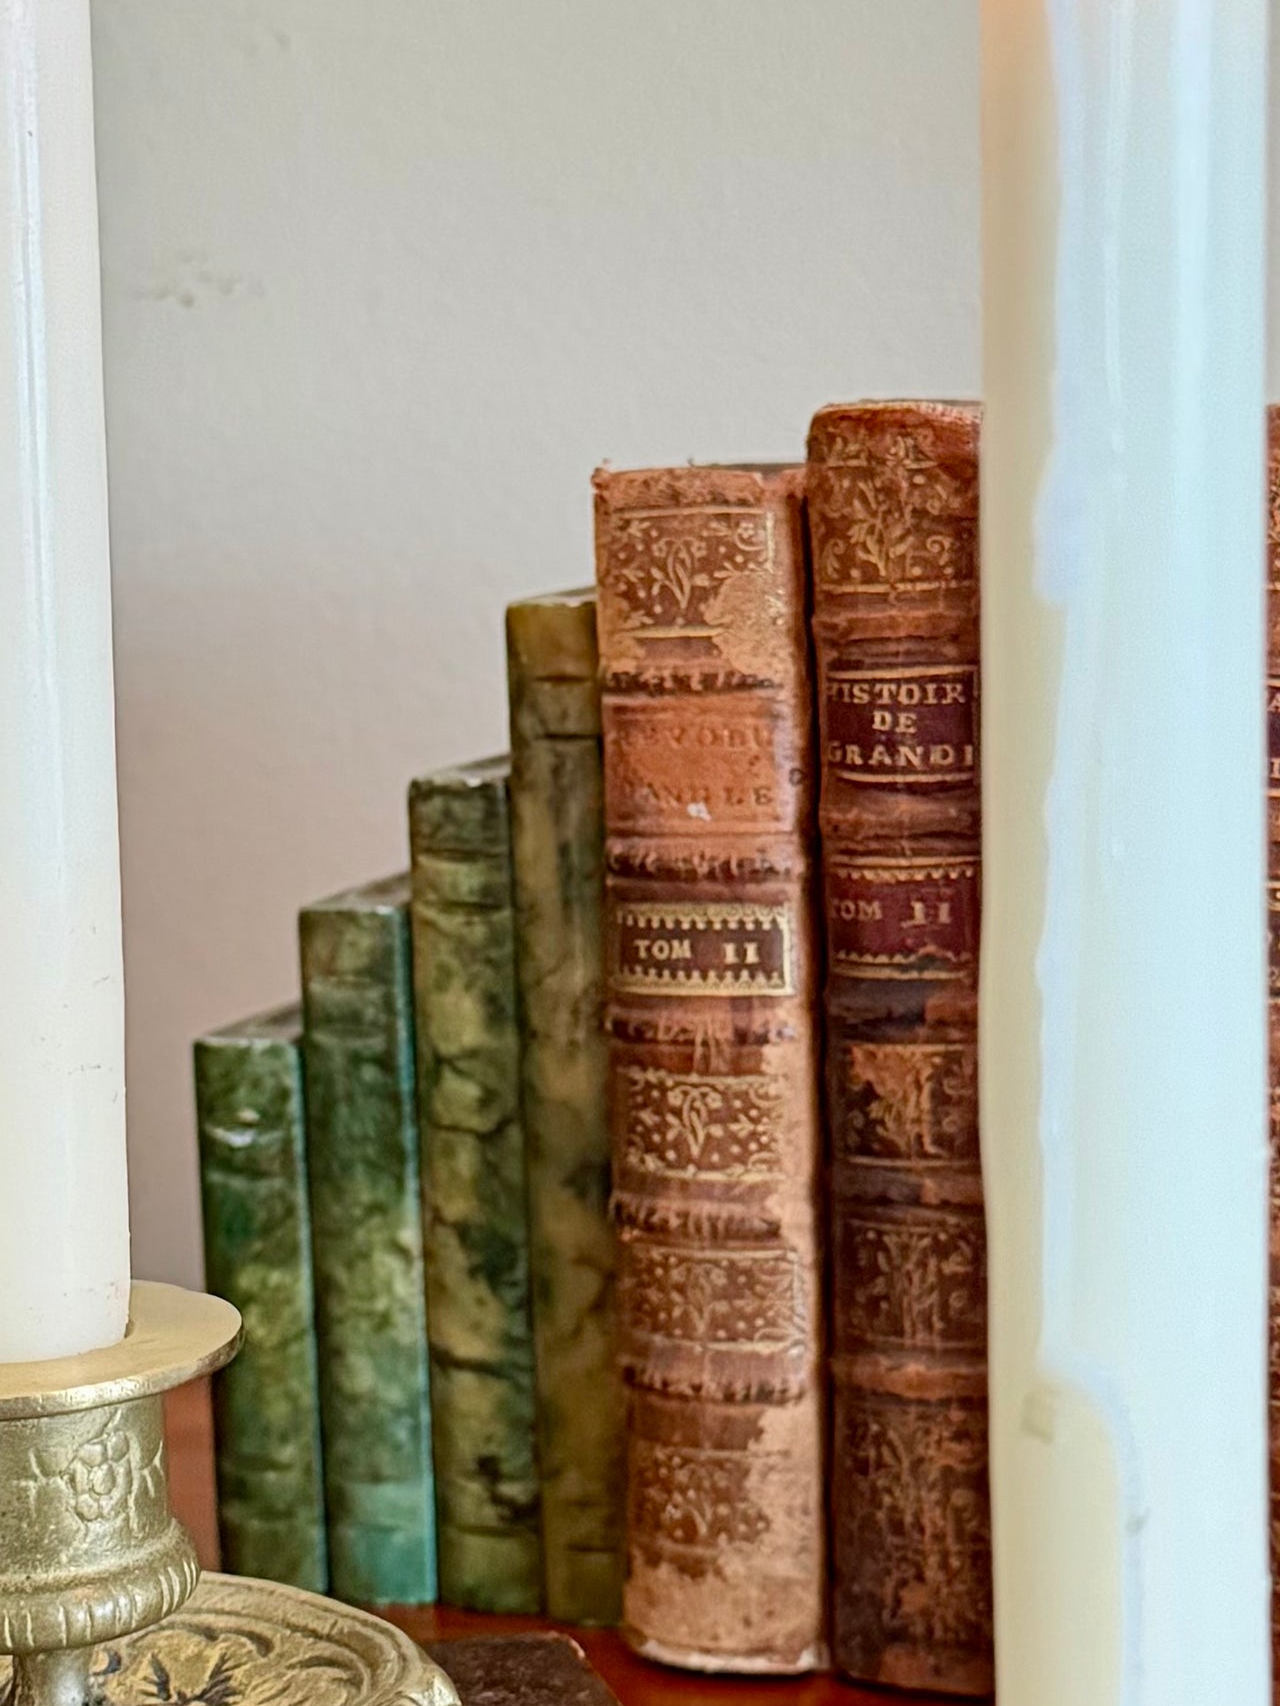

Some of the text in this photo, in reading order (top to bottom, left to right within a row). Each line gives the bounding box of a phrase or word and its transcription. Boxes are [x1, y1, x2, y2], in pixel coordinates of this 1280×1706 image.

[872, 711, 918, 733] DE
[633, 939, 760, 965] TOM II
